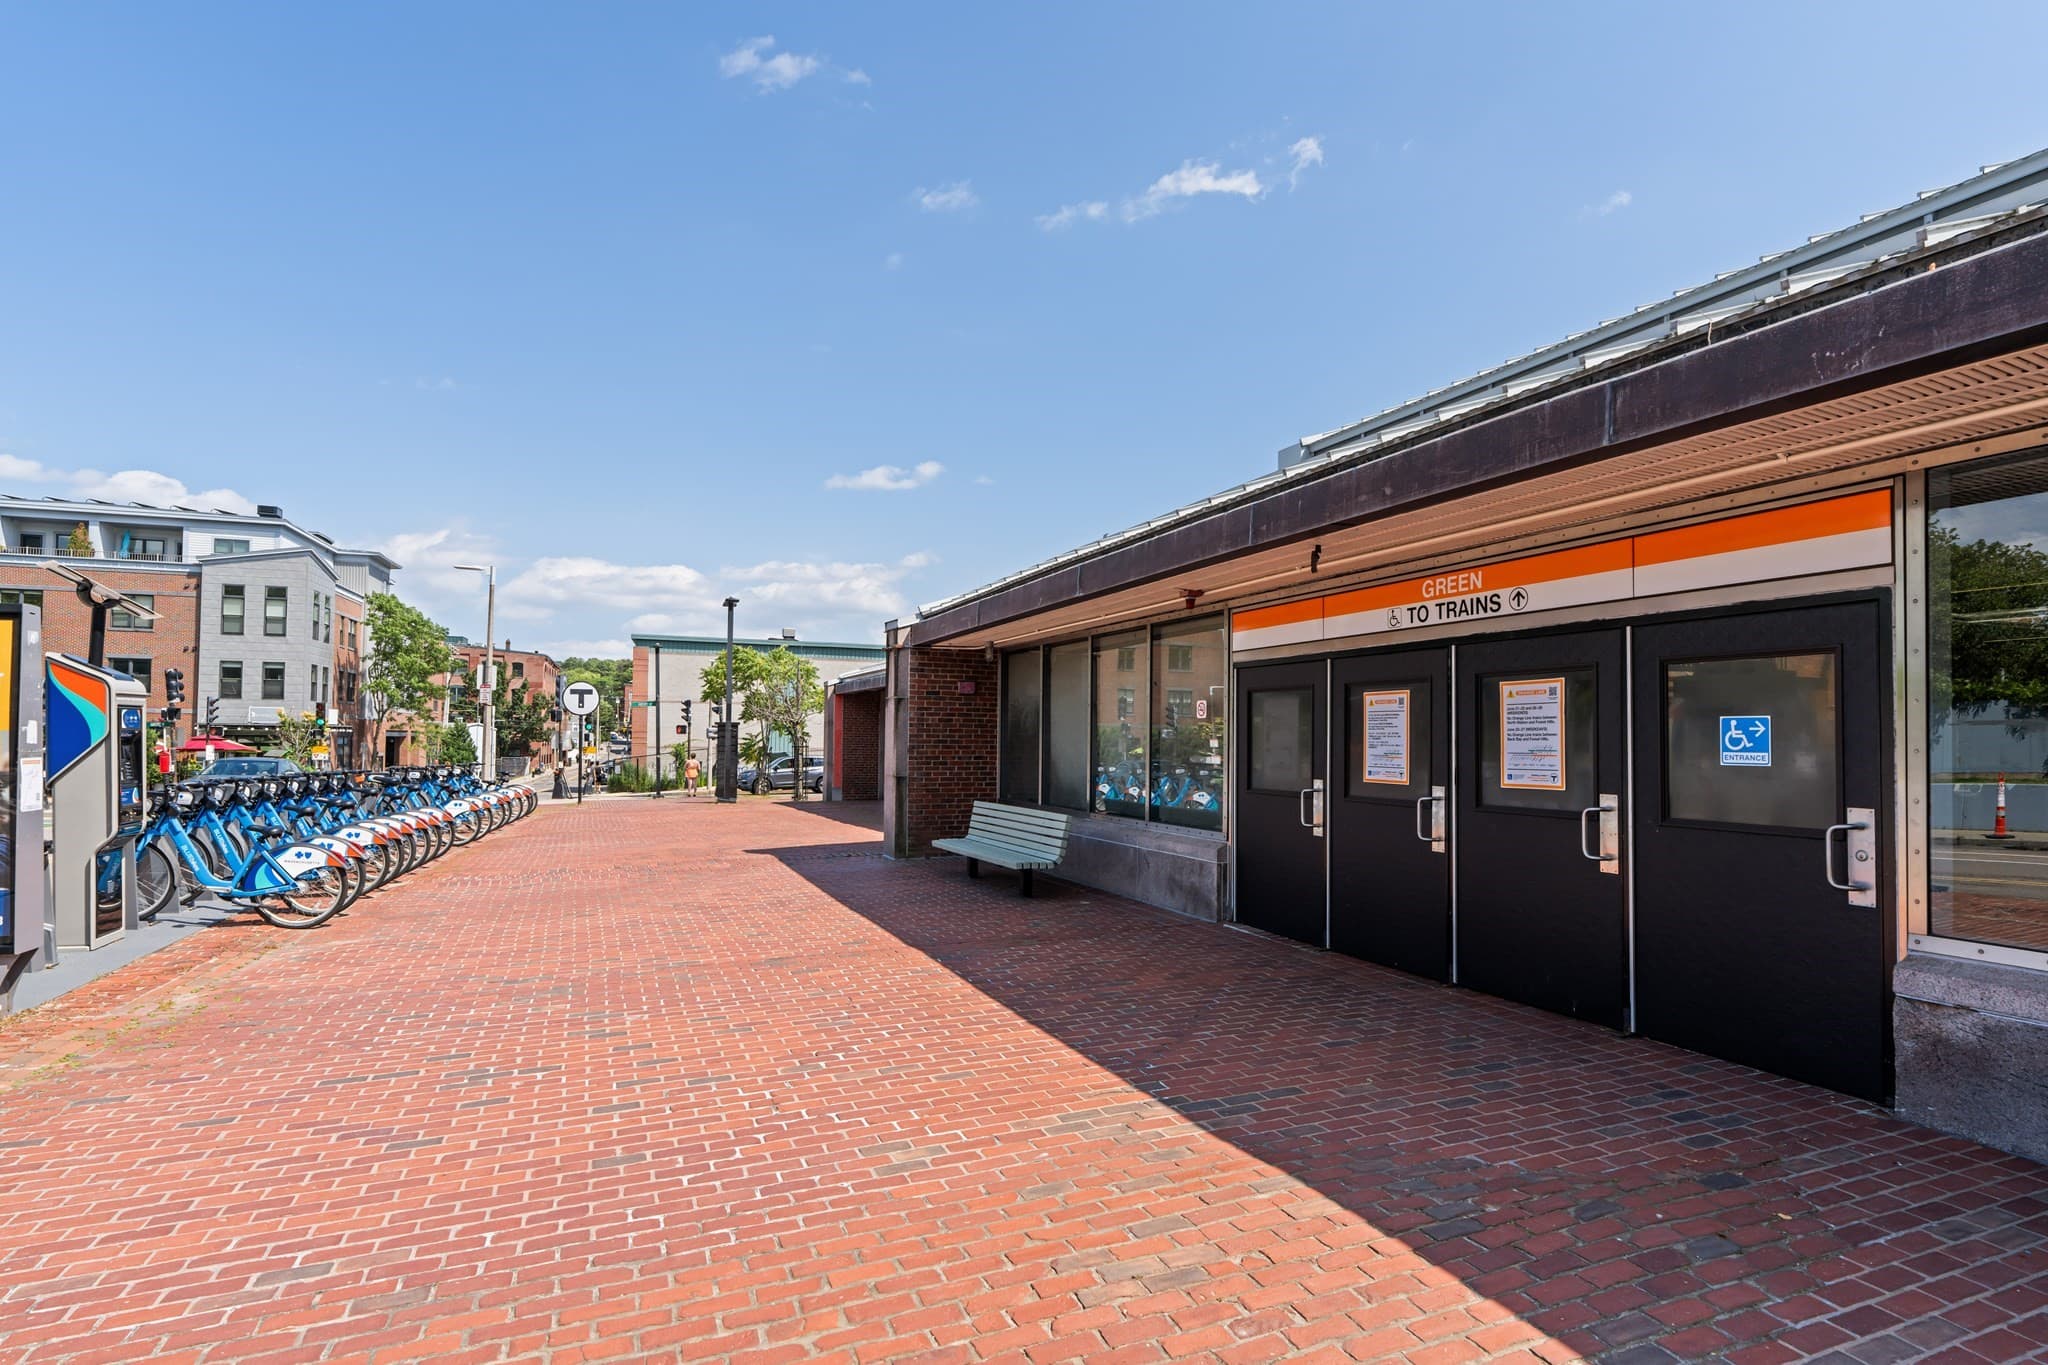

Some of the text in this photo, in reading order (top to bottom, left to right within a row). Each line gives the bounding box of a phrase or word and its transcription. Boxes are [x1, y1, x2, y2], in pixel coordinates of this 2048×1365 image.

[1422, 570, 1483, 598] GREEN
[1406, 593, 1502, 623] TO TRAINS
[570, 689, 593, 708] T
[1724, 753, 1768, 763] ENTRANCE
